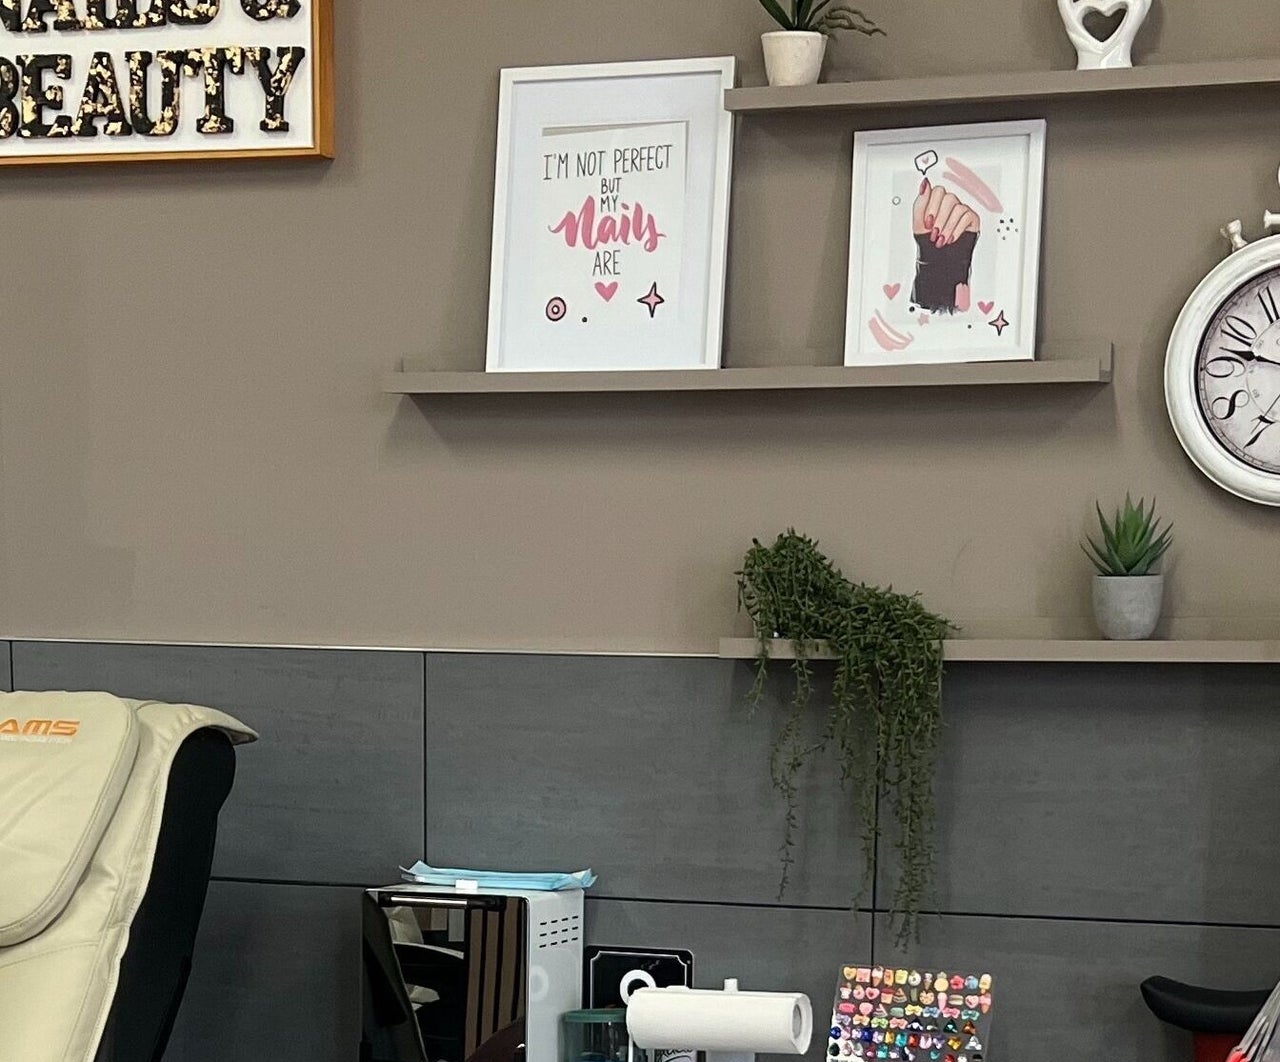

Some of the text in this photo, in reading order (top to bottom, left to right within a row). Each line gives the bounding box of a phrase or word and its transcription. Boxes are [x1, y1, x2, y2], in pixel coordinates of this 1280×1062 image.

[543, 144, 672, 180] I'M NOT PERFECT
[600, 177, 622, 194] BUT
[600, 195, 619, 213] MY
[548, 195, 666, 252] Nails
[592, 250, 621, 276] ARE
[1257, 286, 1280, 324] 11
[1220, 315, 1258, 347] 10
[1205, 356, 1246, 378] 9
[1211, 389, 1250, 420] 8
[1243, 414, 1276, 449] 7
